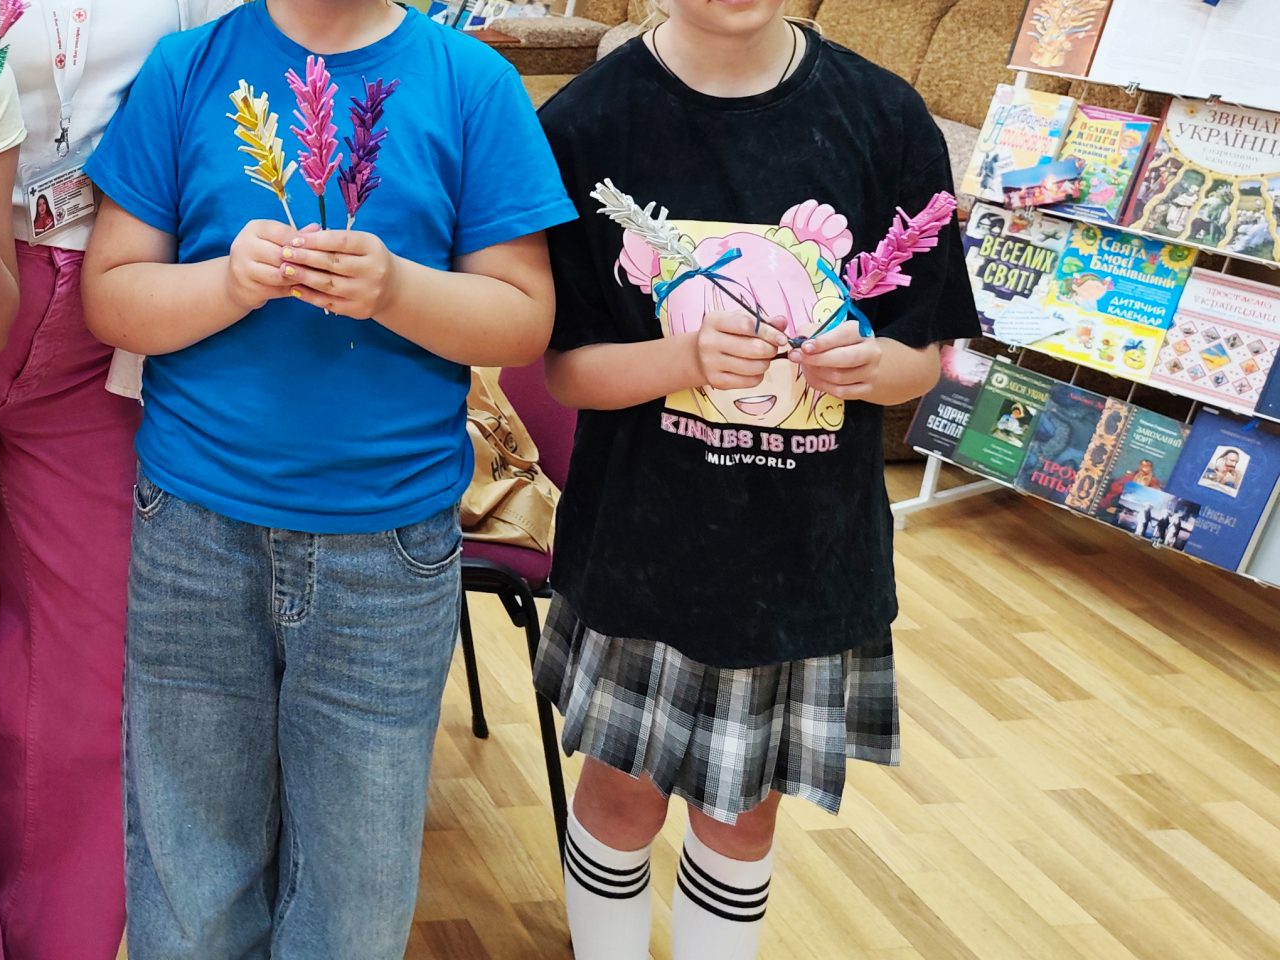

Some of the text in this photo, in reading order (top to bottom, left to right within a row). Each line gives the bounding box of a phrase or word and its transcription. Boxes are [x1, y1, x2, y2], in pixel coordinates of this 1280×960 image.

[979, 234, 1056, 273] ВЕСЕЛИХ
[1101, 236, 1148, 260] СВЯТА
[983, 262, 1035, 295] СВЯТ!
[1107, 305, 1163, 327] КАЛЕНДАР
[1110, 295, 1166, 317] ДИТЯЧИЙ
[937, 403, 970, 426] ЧОРНЕ
[926, 415, 965, 439] ВЕСІЛЛ
[760, 431, 784, 452] IS
[791, 433, 839, 454] COOL
[705, 450, 796, 470] MILYWORLD
[1042, 460, 1078, 480] ТРОХ
